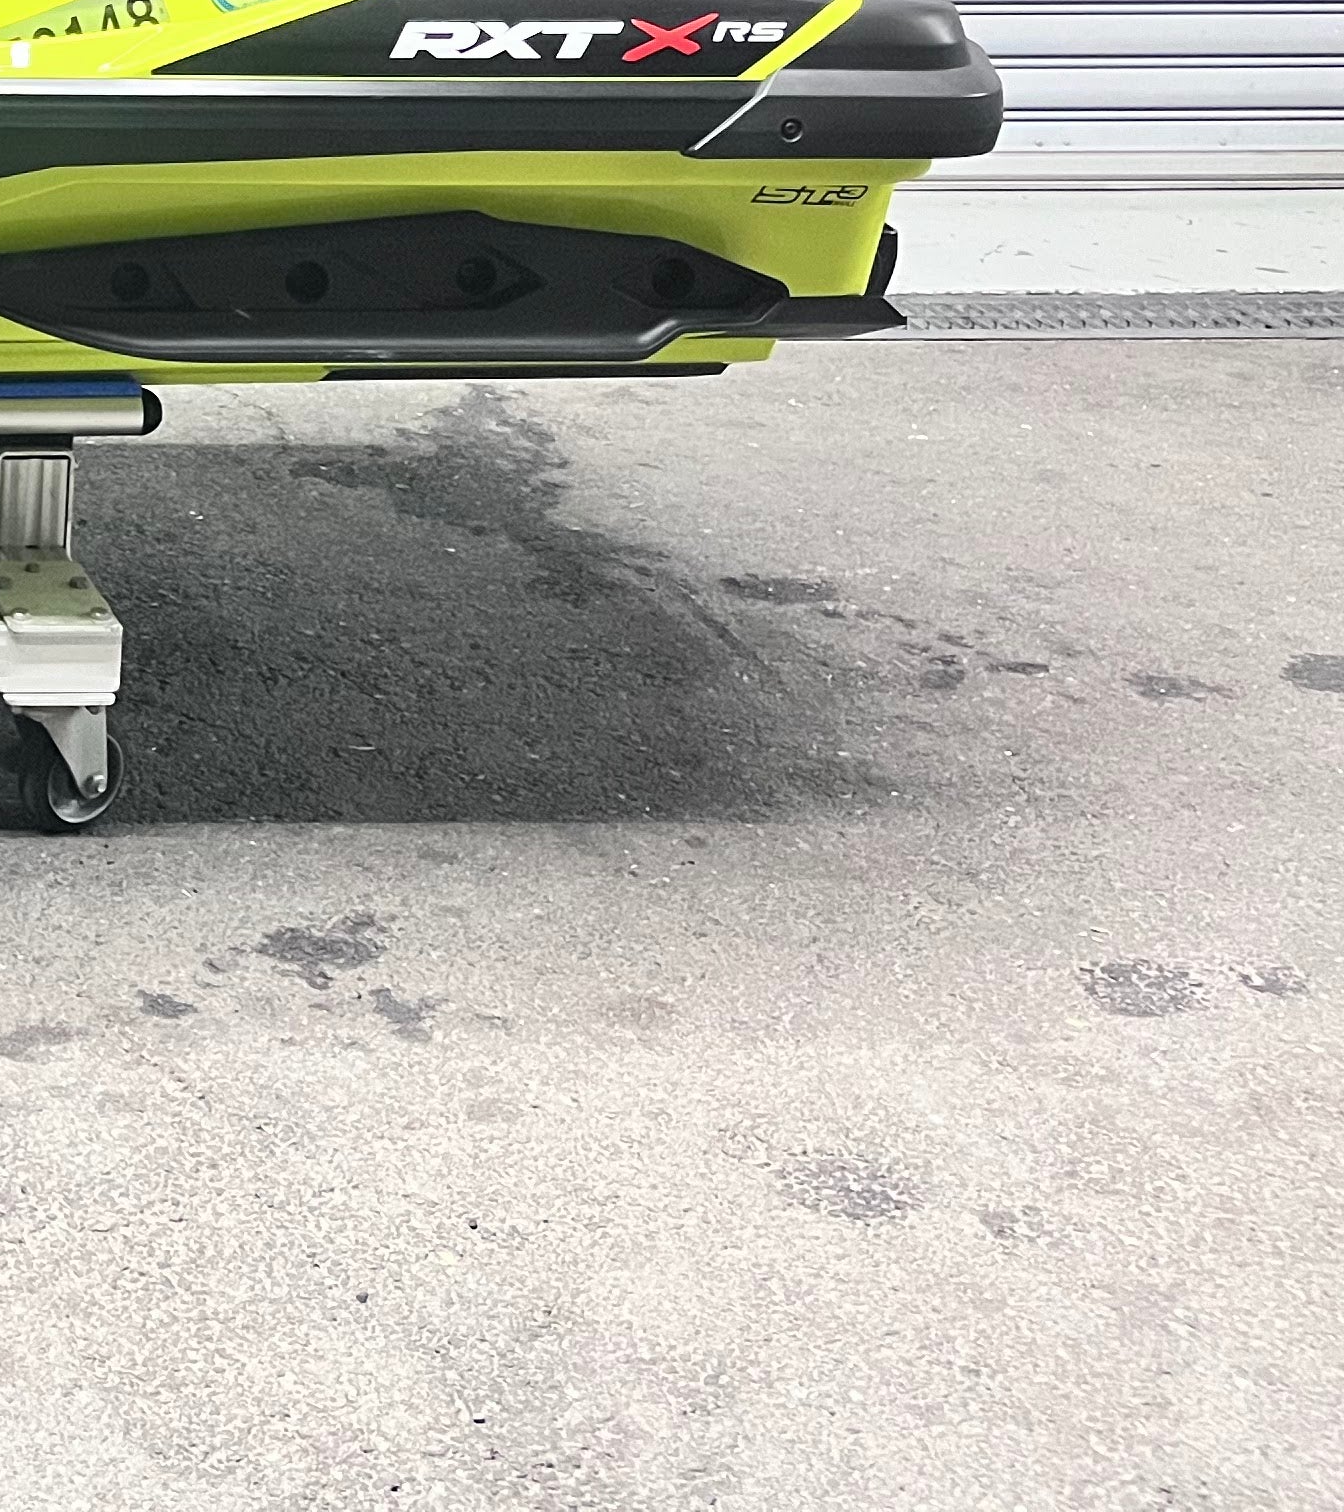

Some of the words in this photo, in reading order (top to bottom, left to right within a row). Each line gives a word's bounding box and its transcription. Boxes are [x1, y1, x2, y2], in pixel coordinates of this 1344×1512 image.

[389, 20, 625, 60] RXT
[621, 11, 721, 62] X
[712, 21, 789, 43] RS
